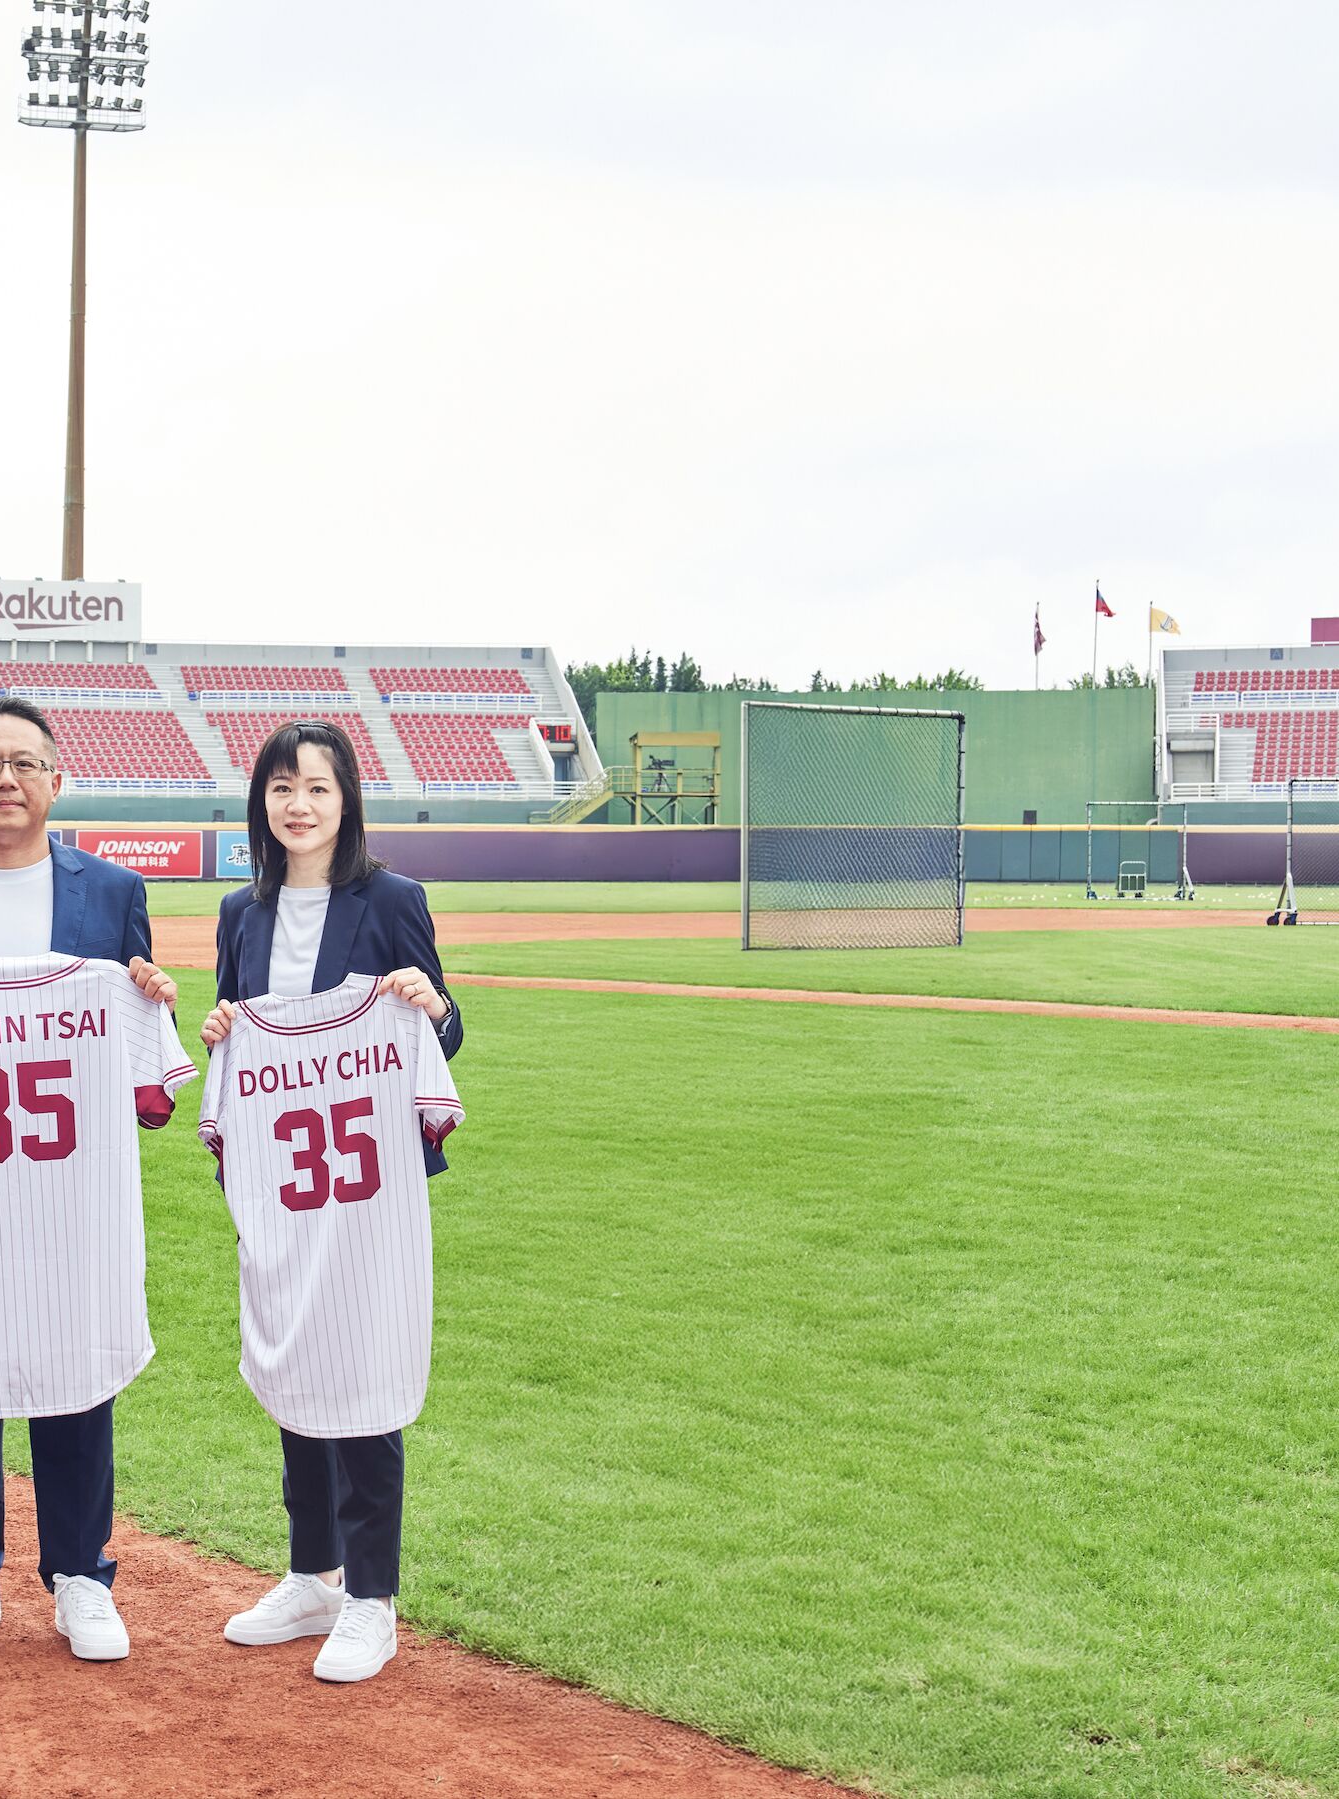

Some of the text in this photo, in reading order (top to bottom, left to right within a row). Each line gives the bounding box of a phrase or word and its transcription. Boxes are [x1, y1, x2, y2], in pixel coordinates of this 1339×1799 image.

[93, 840, 181, 856] JOHNSON
[35, 1008, 107, 1041] TSAI
[237, 1042, 403, 1098] DOLLY CHIA
[273, 1096, 382, 1212] 35
